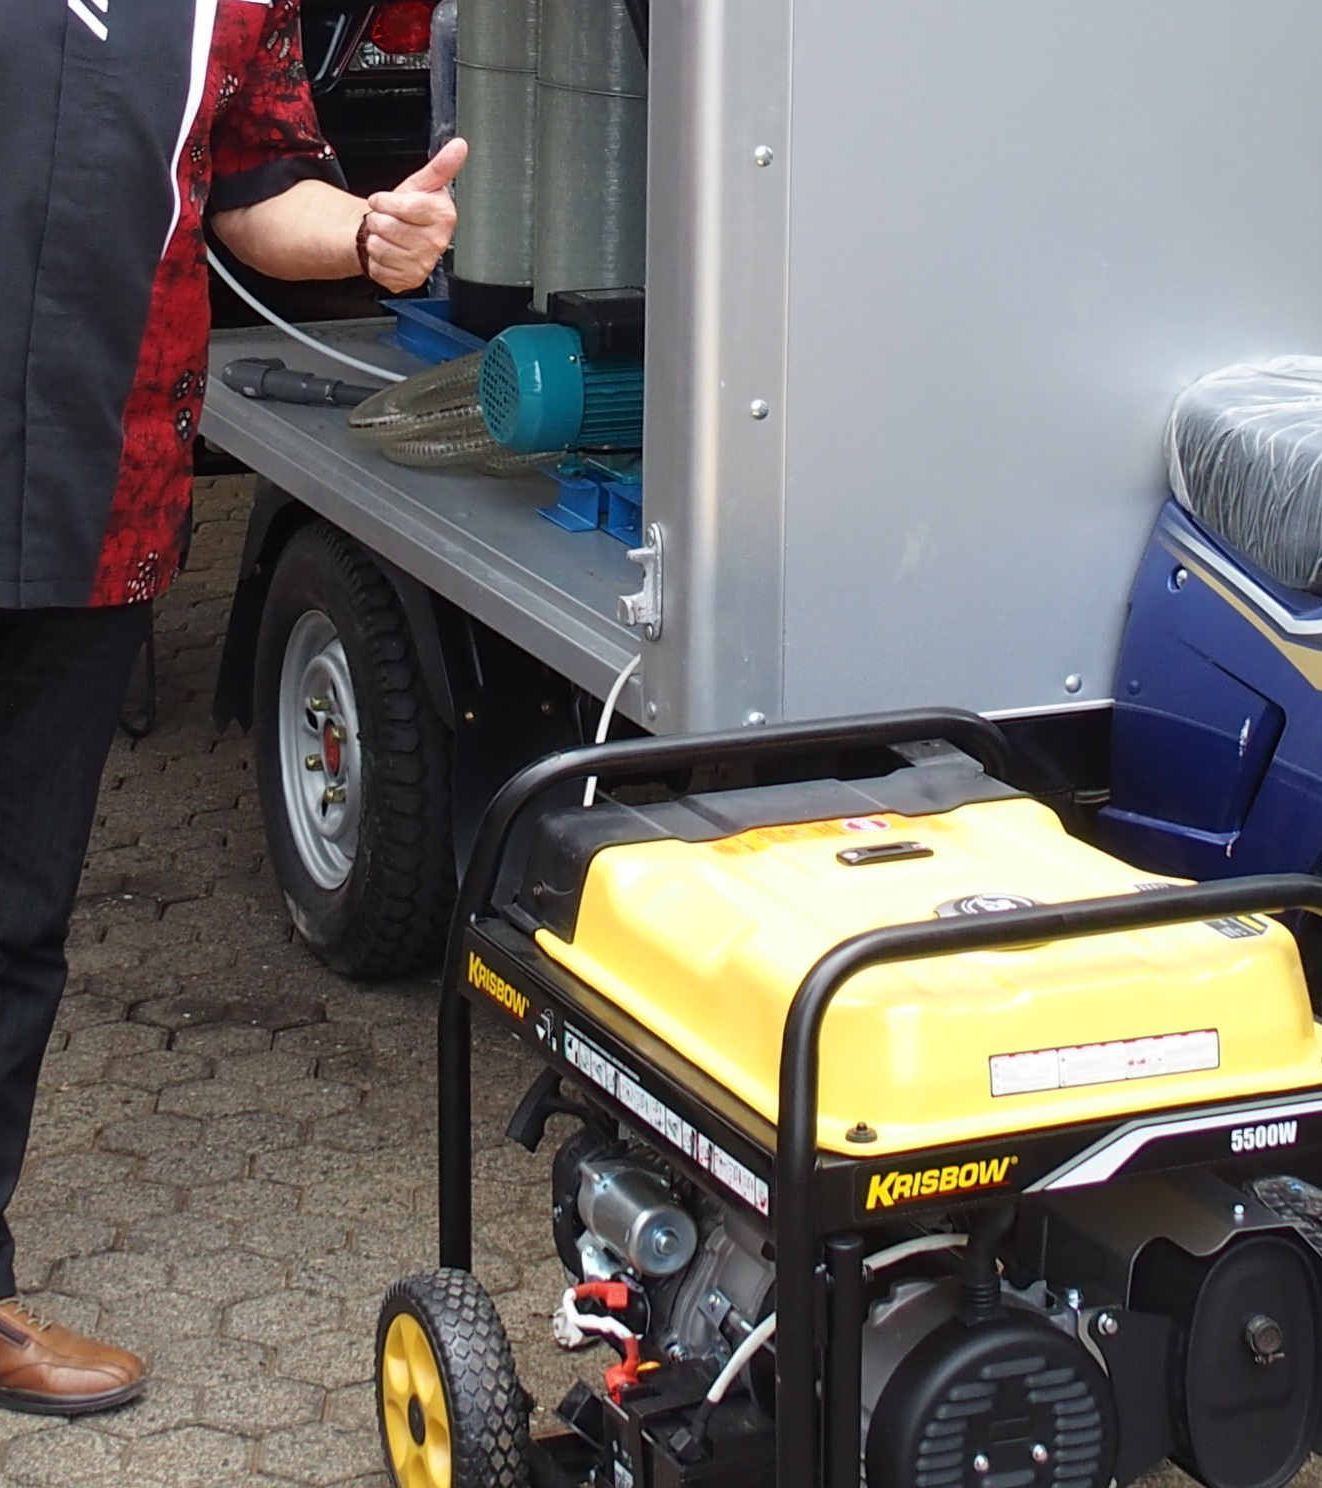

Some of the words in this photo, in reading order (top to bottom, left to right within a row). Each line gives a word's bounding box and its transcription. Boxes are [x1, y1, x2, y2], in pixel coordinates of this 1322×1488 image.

[468, 951, 526, 1019] KRISBOW
[1231, 1120, 1297, 1152] 5500W
[866, 1157, 1010, 1210] KRISBOW
